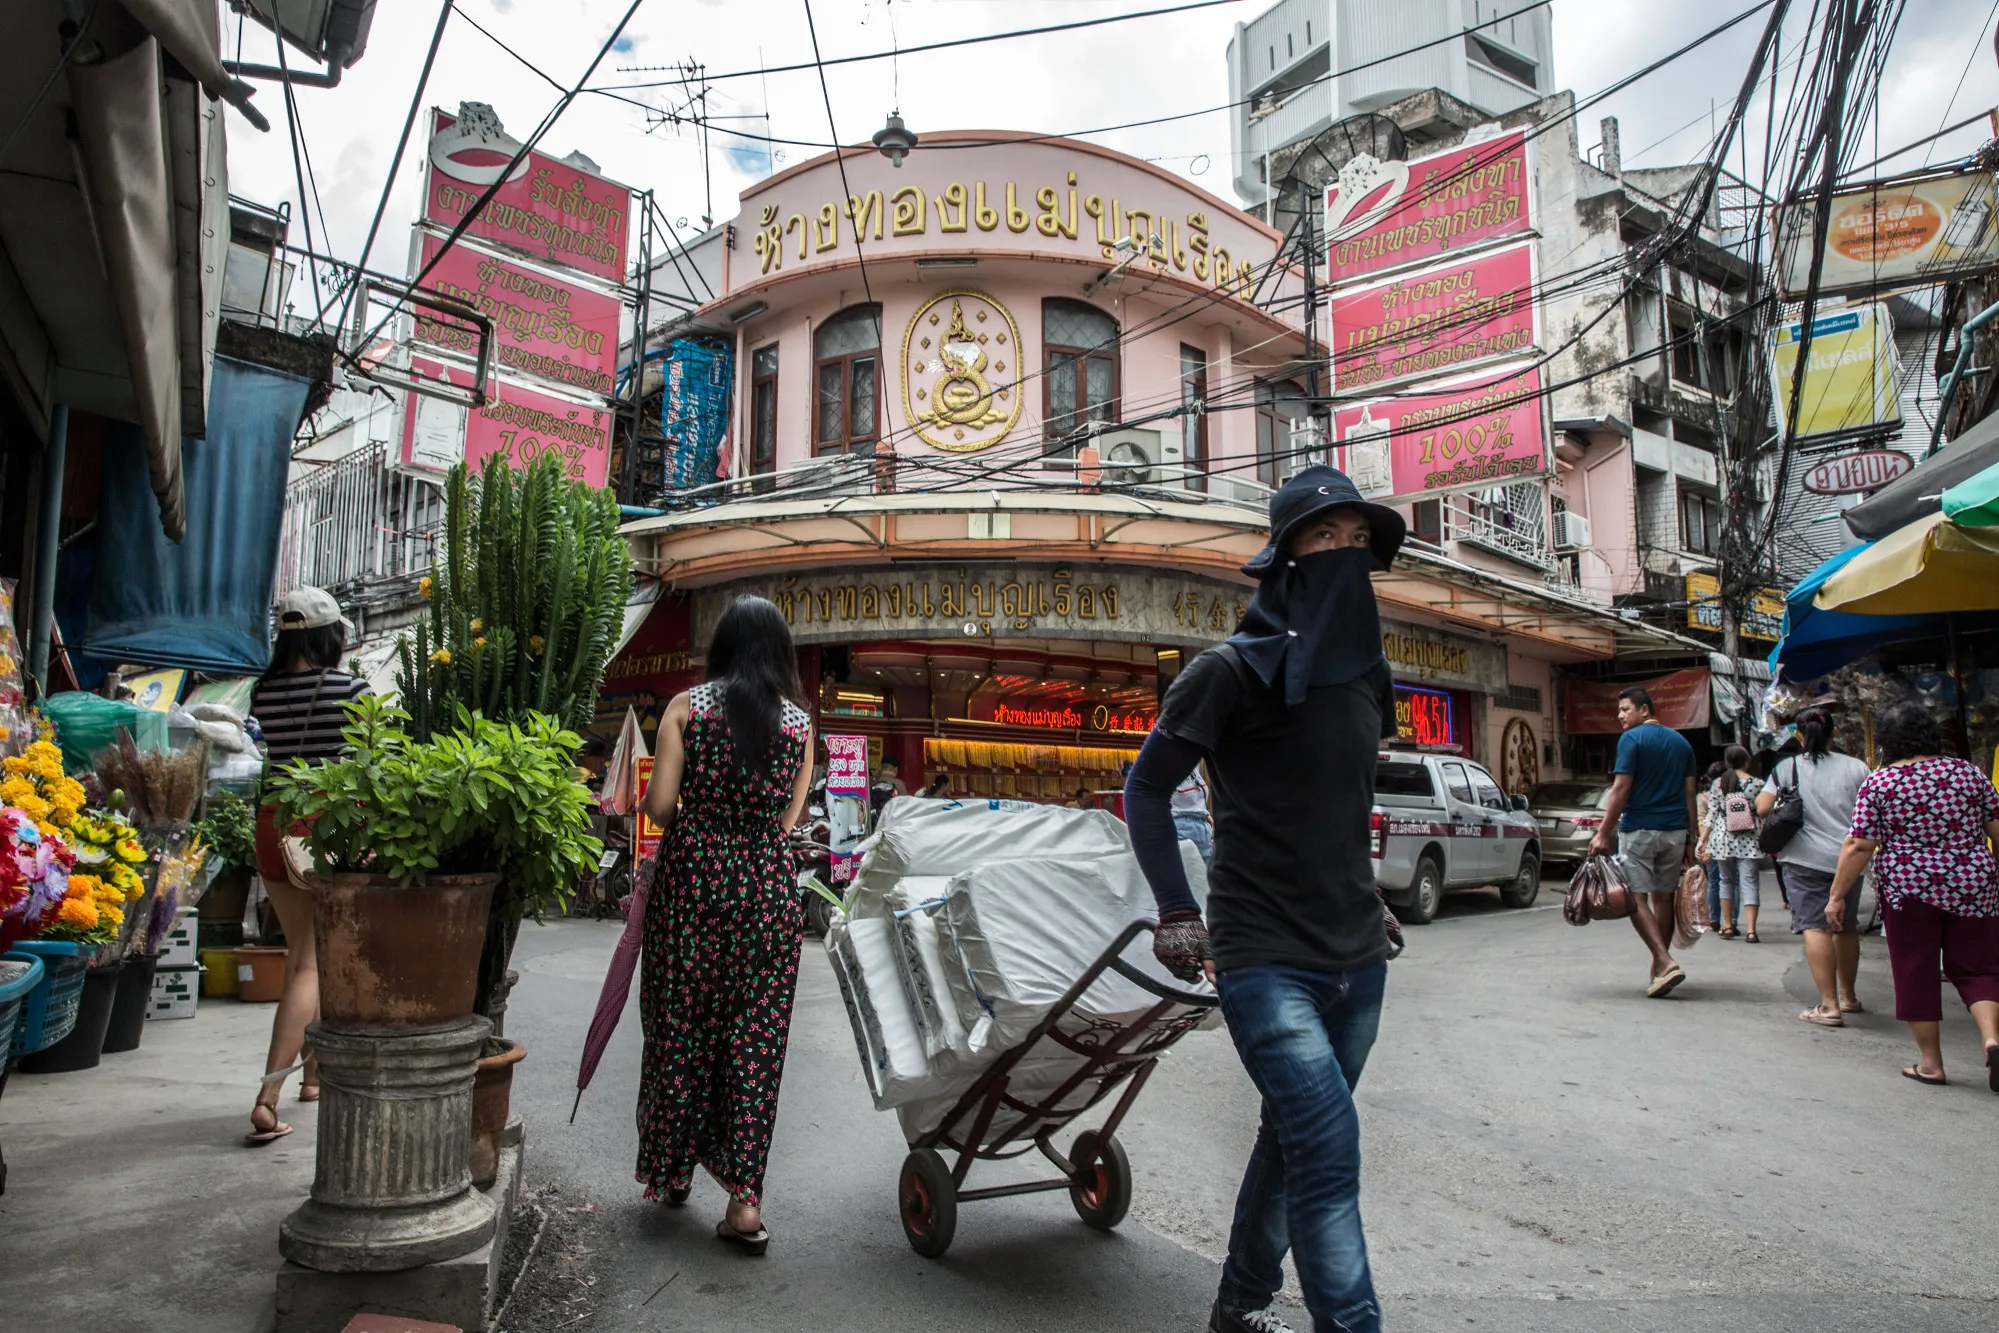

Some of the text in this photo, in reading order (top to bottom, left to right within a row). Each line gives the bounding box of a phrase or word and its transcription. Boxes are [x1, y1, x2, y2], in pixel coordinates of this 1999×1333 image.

[529, 168, 624, 232] รับสั่งทำ
[1417, 151, 1522, 209] รับสั่งทำ
[754, 171, 1255, 302] ห้างทองแม่บุญเรือง
[1335, 190, 1521, 268] งานเพชรทุกชนิด
[478, 259, 571, 308] ห้างทอง
[1381, 269, 1473, 311] ห้างทอง
[434, 281, 605, 356] แม่บญเรือง
[1345, 288, 1516, 356] แม่บุญเรือง
[418, 311, 611, 391] รับซื้อ-ายทองคำแท่ง
[1338, 326, 1531, 390] รับซื้อ-ขายทองคำแท่ง
[480, 394, 605, 452] กรอบพระกันน้ำ
[1400, 373, 1532, 433] กรอบพระกันน้ำ
[498, 429, 586, 479] 100%
[1419, 416, 1514, 465] 100%
[1424, 452, 1539, 490] รอรับได้เลย
[773, 569, 1120, 636] ห้างทองแม่บุญเรือง
[994, 703, 1082, 729] ห้างทองแม่บุญเรือง
[829, 738, 864, 759] เจาะหู
[829, 758, 865, 772] 250 บาท
[828, 770, 866, 788] ด้วยเครื่อง
[834, 857, 852, 880] ฟรี
